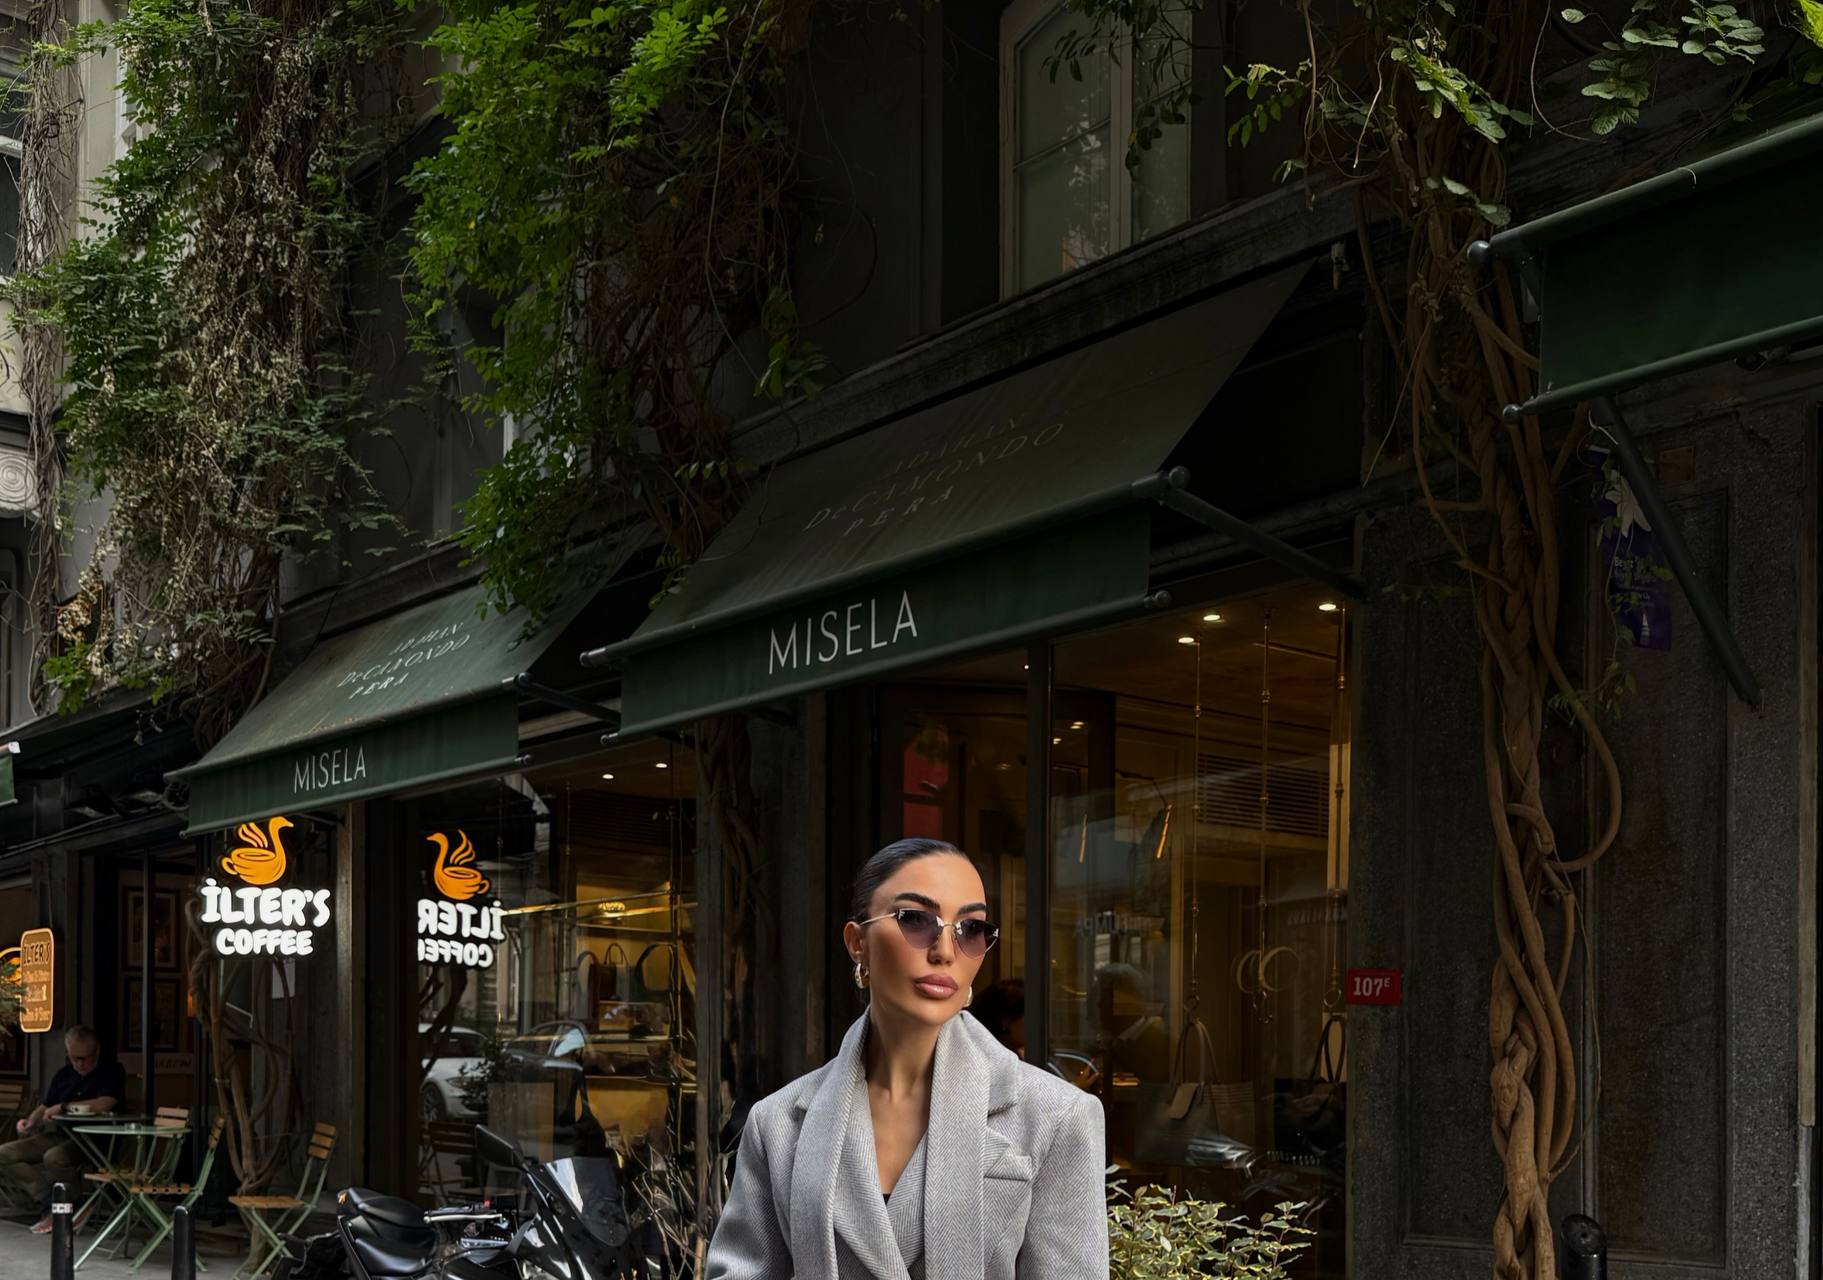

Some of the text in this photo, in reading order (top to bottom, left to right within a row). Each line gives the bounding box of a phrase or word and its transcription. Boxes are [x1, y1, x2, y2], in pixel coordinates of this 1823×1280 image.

[841, 485, 955, 537] PERA
[768, 589, 918, 675] MISELA
[294, 745, 366, 794] MISELA
[216, 928, 314, 956] COFFEE
